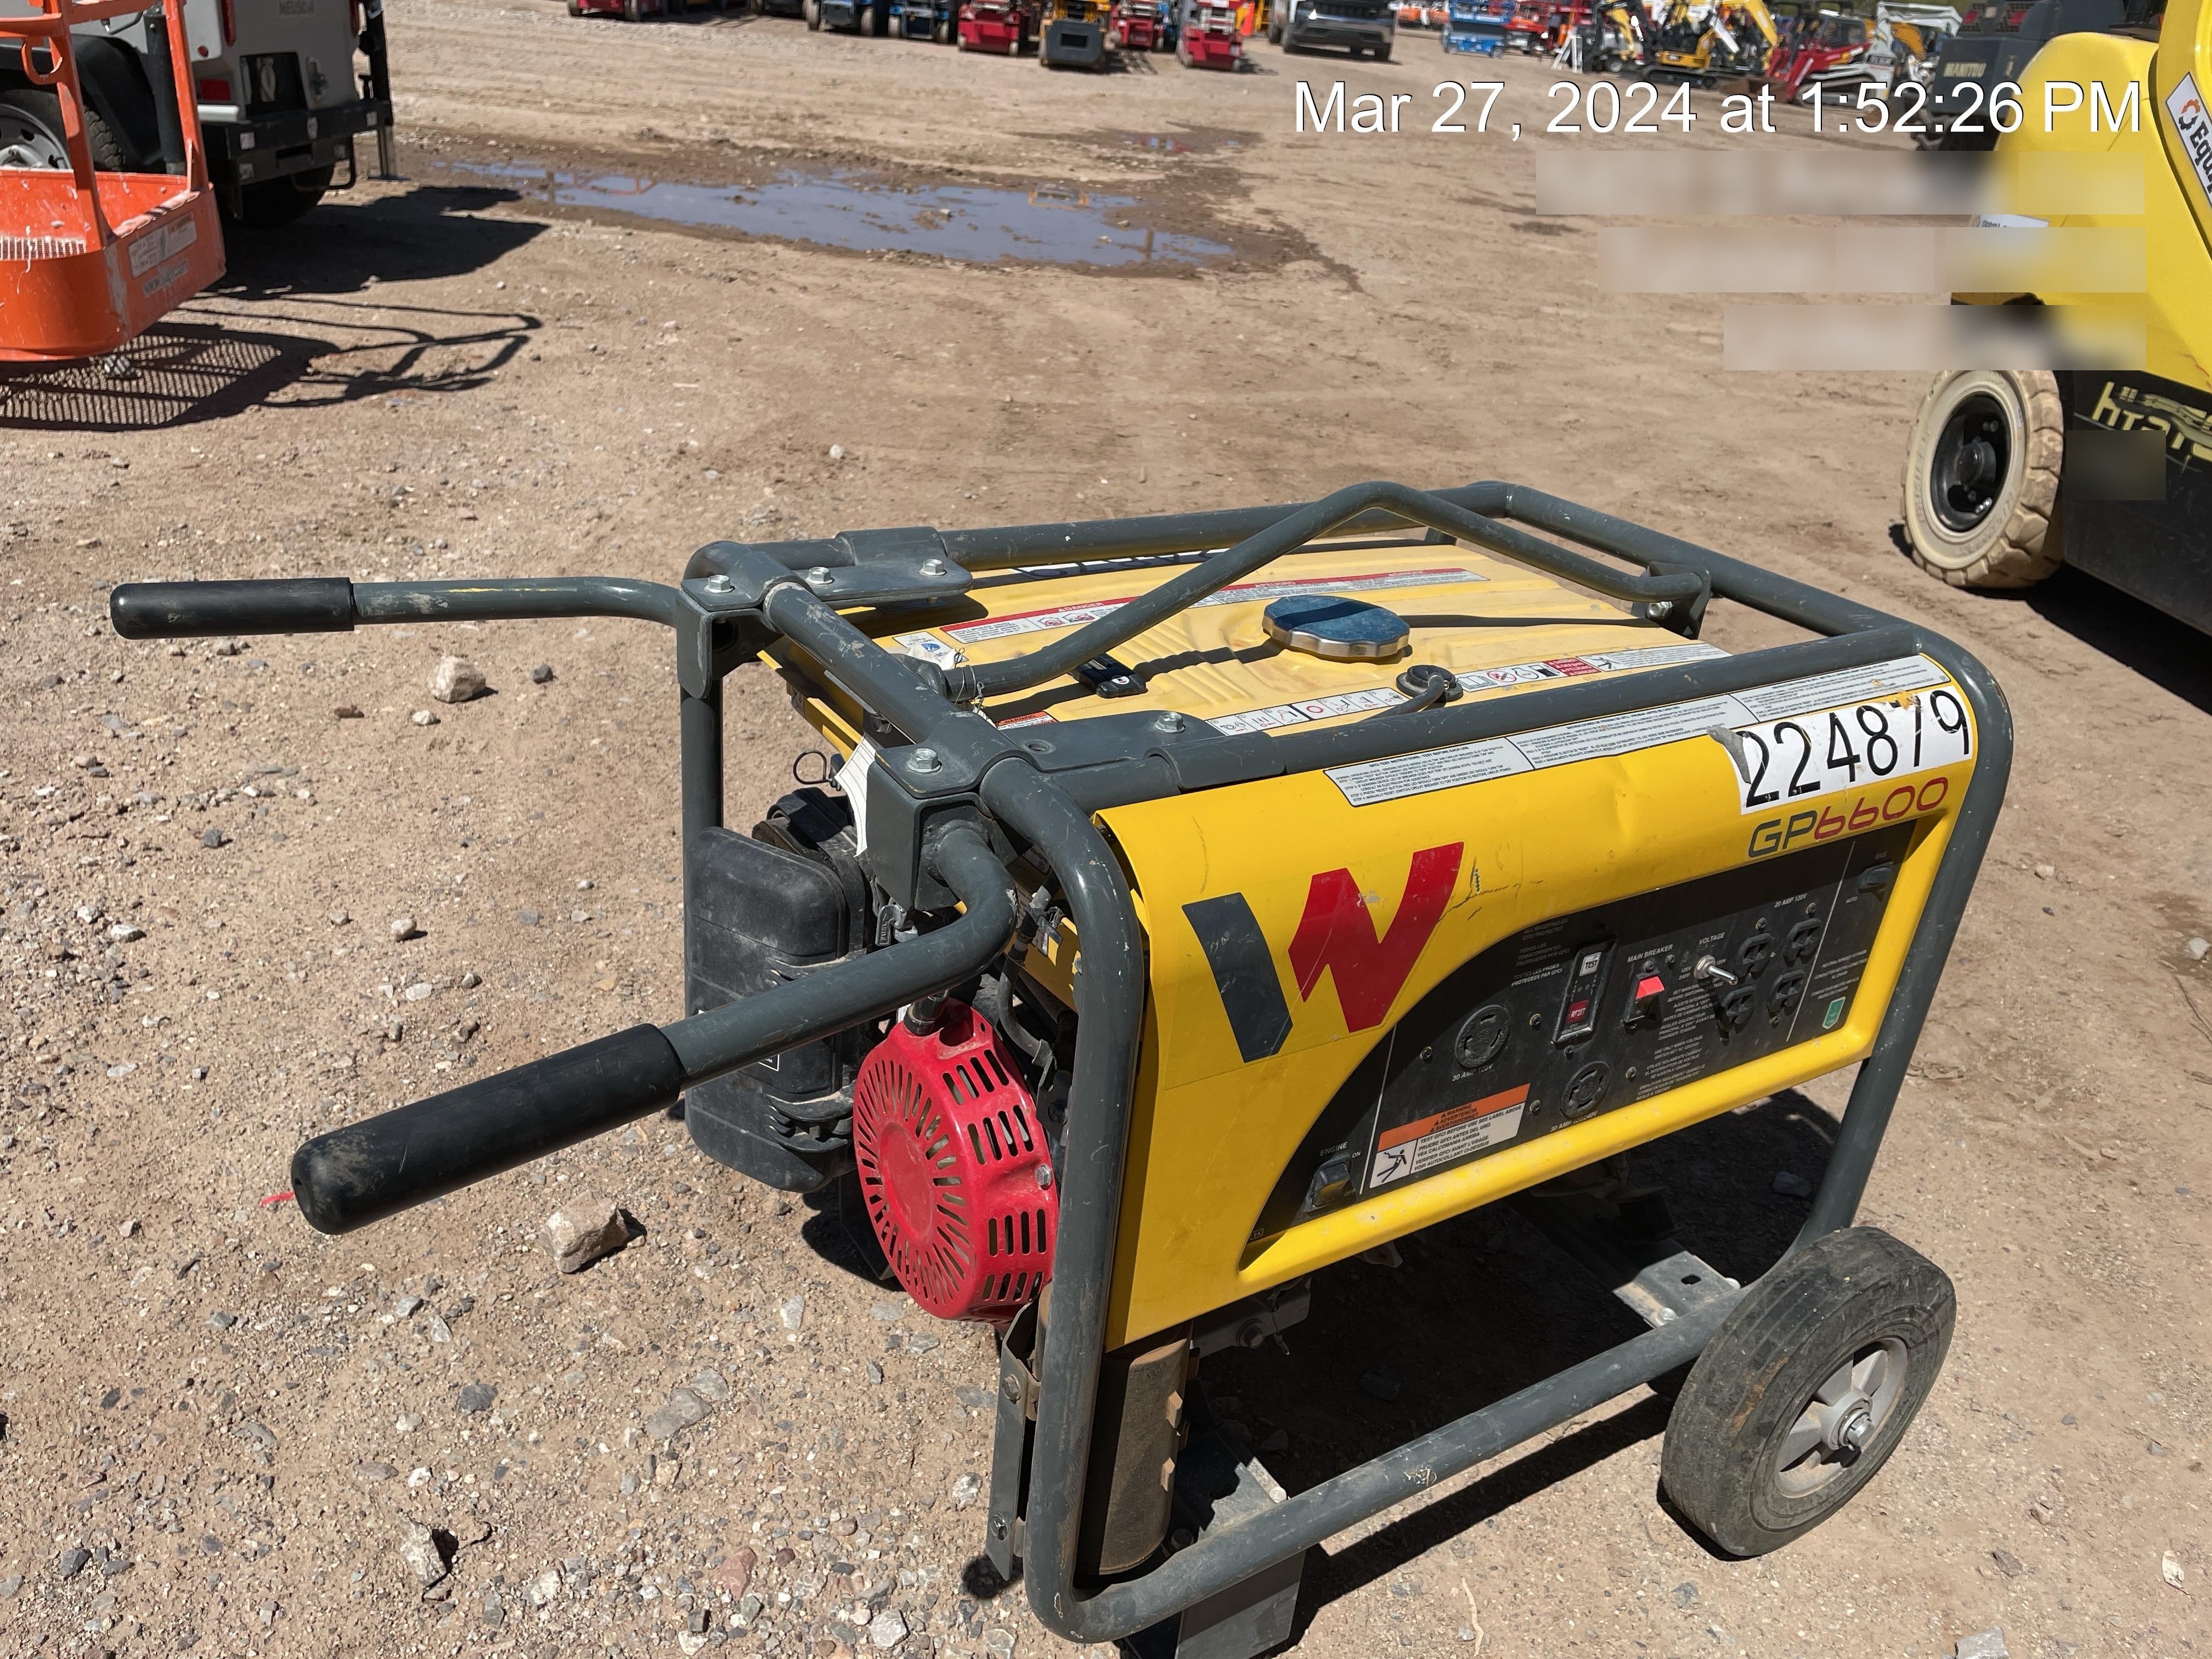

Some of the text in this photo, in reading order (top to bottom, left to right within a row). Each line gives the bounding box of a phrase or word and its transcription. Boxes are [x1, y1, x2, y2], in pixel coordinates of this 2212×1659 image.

[2189, 120, 2212, 194] Equ
[1064, 601, 1104, 612] DANGER
[1748, 776, 1949, 858] GP6600
[1781, 897, 1795, 906] AMP
[1699, 932, 1725, 945] VOLTAGE
[1627, 944, 1673, 963] MAIN BREAKER
[1585, 959, 1598, 969] TEST
[1452, 1074, 1460, 1082] 30
[1440, 1107, 1477, 1124] ADVERTENCIA
[1446, 1104, 1472, 1116] WARNING
[1420, 1135, 1434, 1144] TEST
[1434, 1131, 1446, 1139] GFCI
[1447, 1124, 1466, 1135] BEFORE
[1489, 1111, 1504, 1120] LABEL
[1505, 1105, 1522, 1115] ABOVE
[1558, 1120, 1572, 1130] AMP
[1418, 1140, 1439, 1151] PRUEBE
[1452, 1130, 1469, 1139] ANTES
[1427, 1138, 1461, 1153] CALCOMANIA
[1462, 1131, 1480, 1142] ARRIBA
[1320, 1141, 1348, 1156] ENGINE
[1352, 1150, 1361, 1159] ON
[1414, 1140, 1489, 1171] VOIR AUTOCOLLANT CI-DESSUS
[1415, 1153, 1438, 1165] VERIFIER
[1451, 1142, 1468, 1152] AVANT
[1344, 1188, 1356, 1197] OFF
